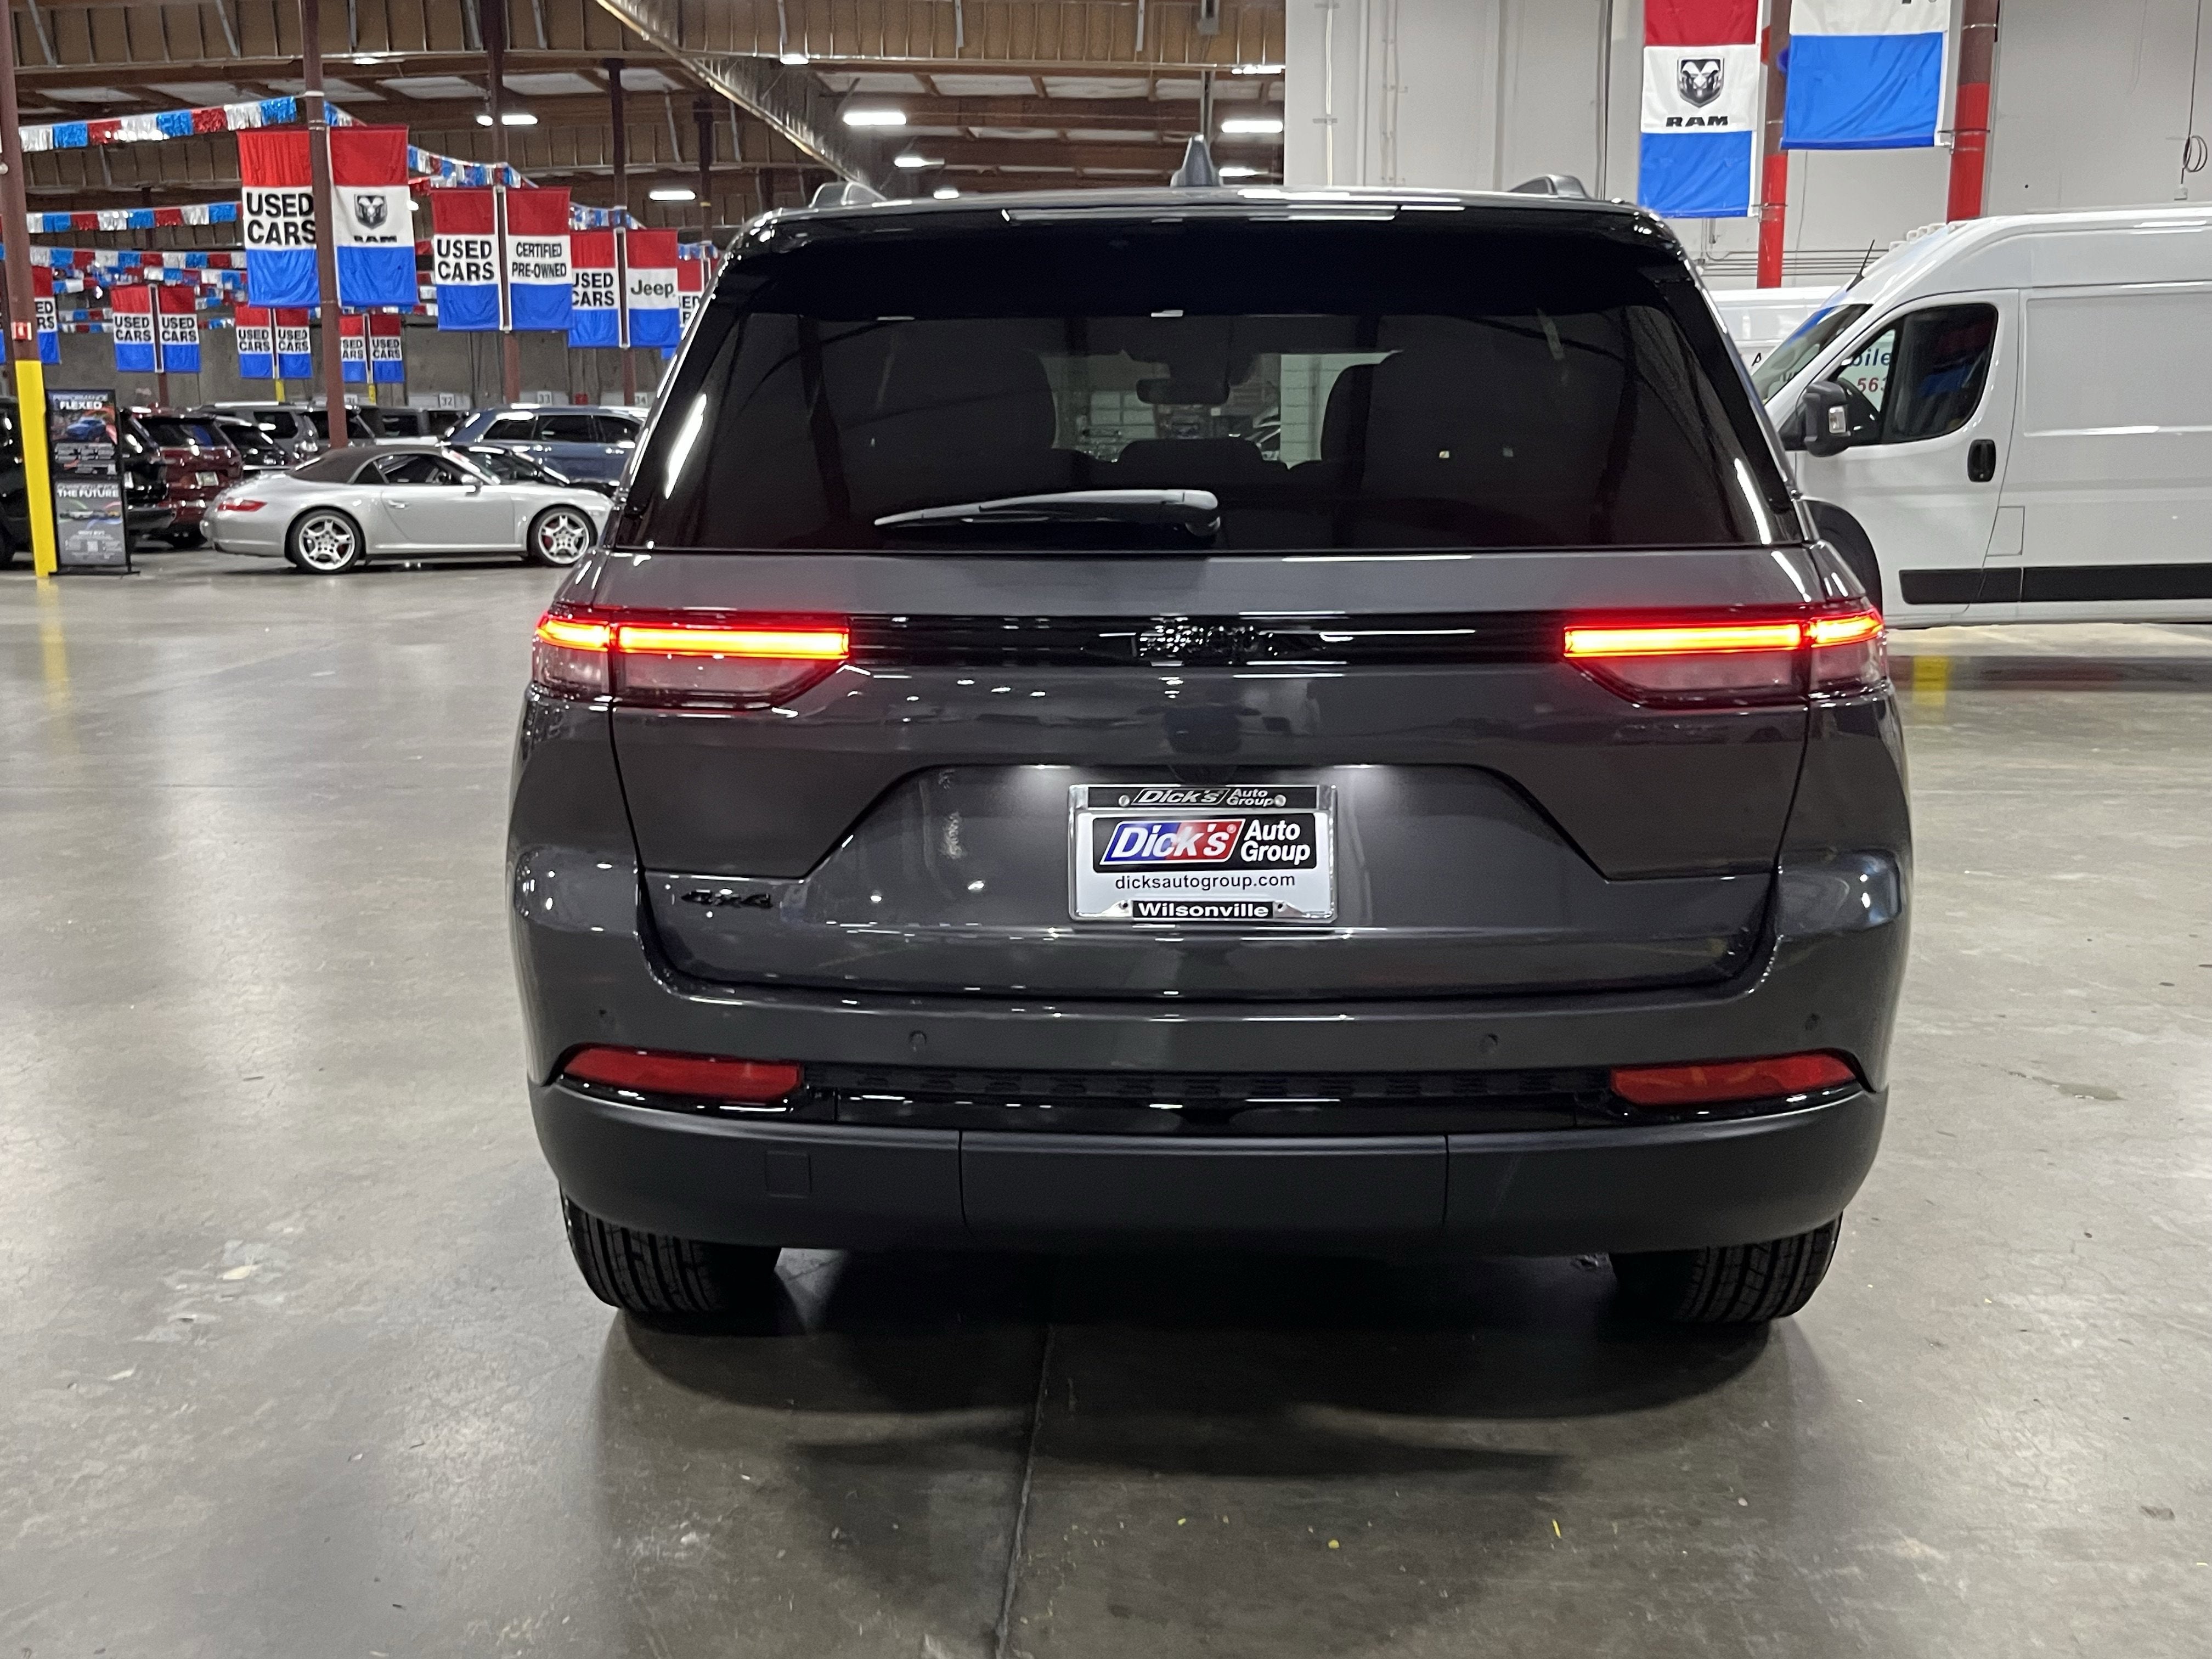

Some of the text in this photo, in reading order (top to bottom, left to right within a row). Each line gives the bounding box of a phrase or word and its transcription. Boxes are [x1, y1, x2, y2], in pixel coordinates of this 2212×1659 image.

[1666, 116, 1728, 127] RAM
[246, 193, 314, 218] USED
[247, 219, 315, 245] CARS
[437, 239, 492, 259] USED
[516, 242, 562, 258] CERTIFIED
[438, 261, 494, 281] CARS
[512, 261, 566, 278] PRE-OWNED
[631, 279, 674, 298] Jeep
[36, 301, 53, 314] ED
[37, 316, 55, 329] RS
[115, 316, 149, 329] USED
[162, 317, 195, 329] USED
[116, 330, 151, 341] CARS
[162, 330, 196, 342] CARS
[239, 329, 269, 340] USED
[278, 330, 307, 340] USED
[239, 341, 270, 352] CARS
[278, 341, 308, 352] CARS
[343, 339, 363, 349] SED
[372, 338, 399, 348] USED
[343, 350, 363, 359] ARS
[373, 349, 400, 358] CARS
[1138, 788, 1268, 803] Dick's Auto
[1226, 797, 1274, 807] Group
[1111, 820, 1301, 857] Dick's Auto
[1241, 842, 1311, 865] Group
[1115, 874, 1295, 890] dicksautogroup.com
[1138, 903, 1269, 917] Wilsonville
